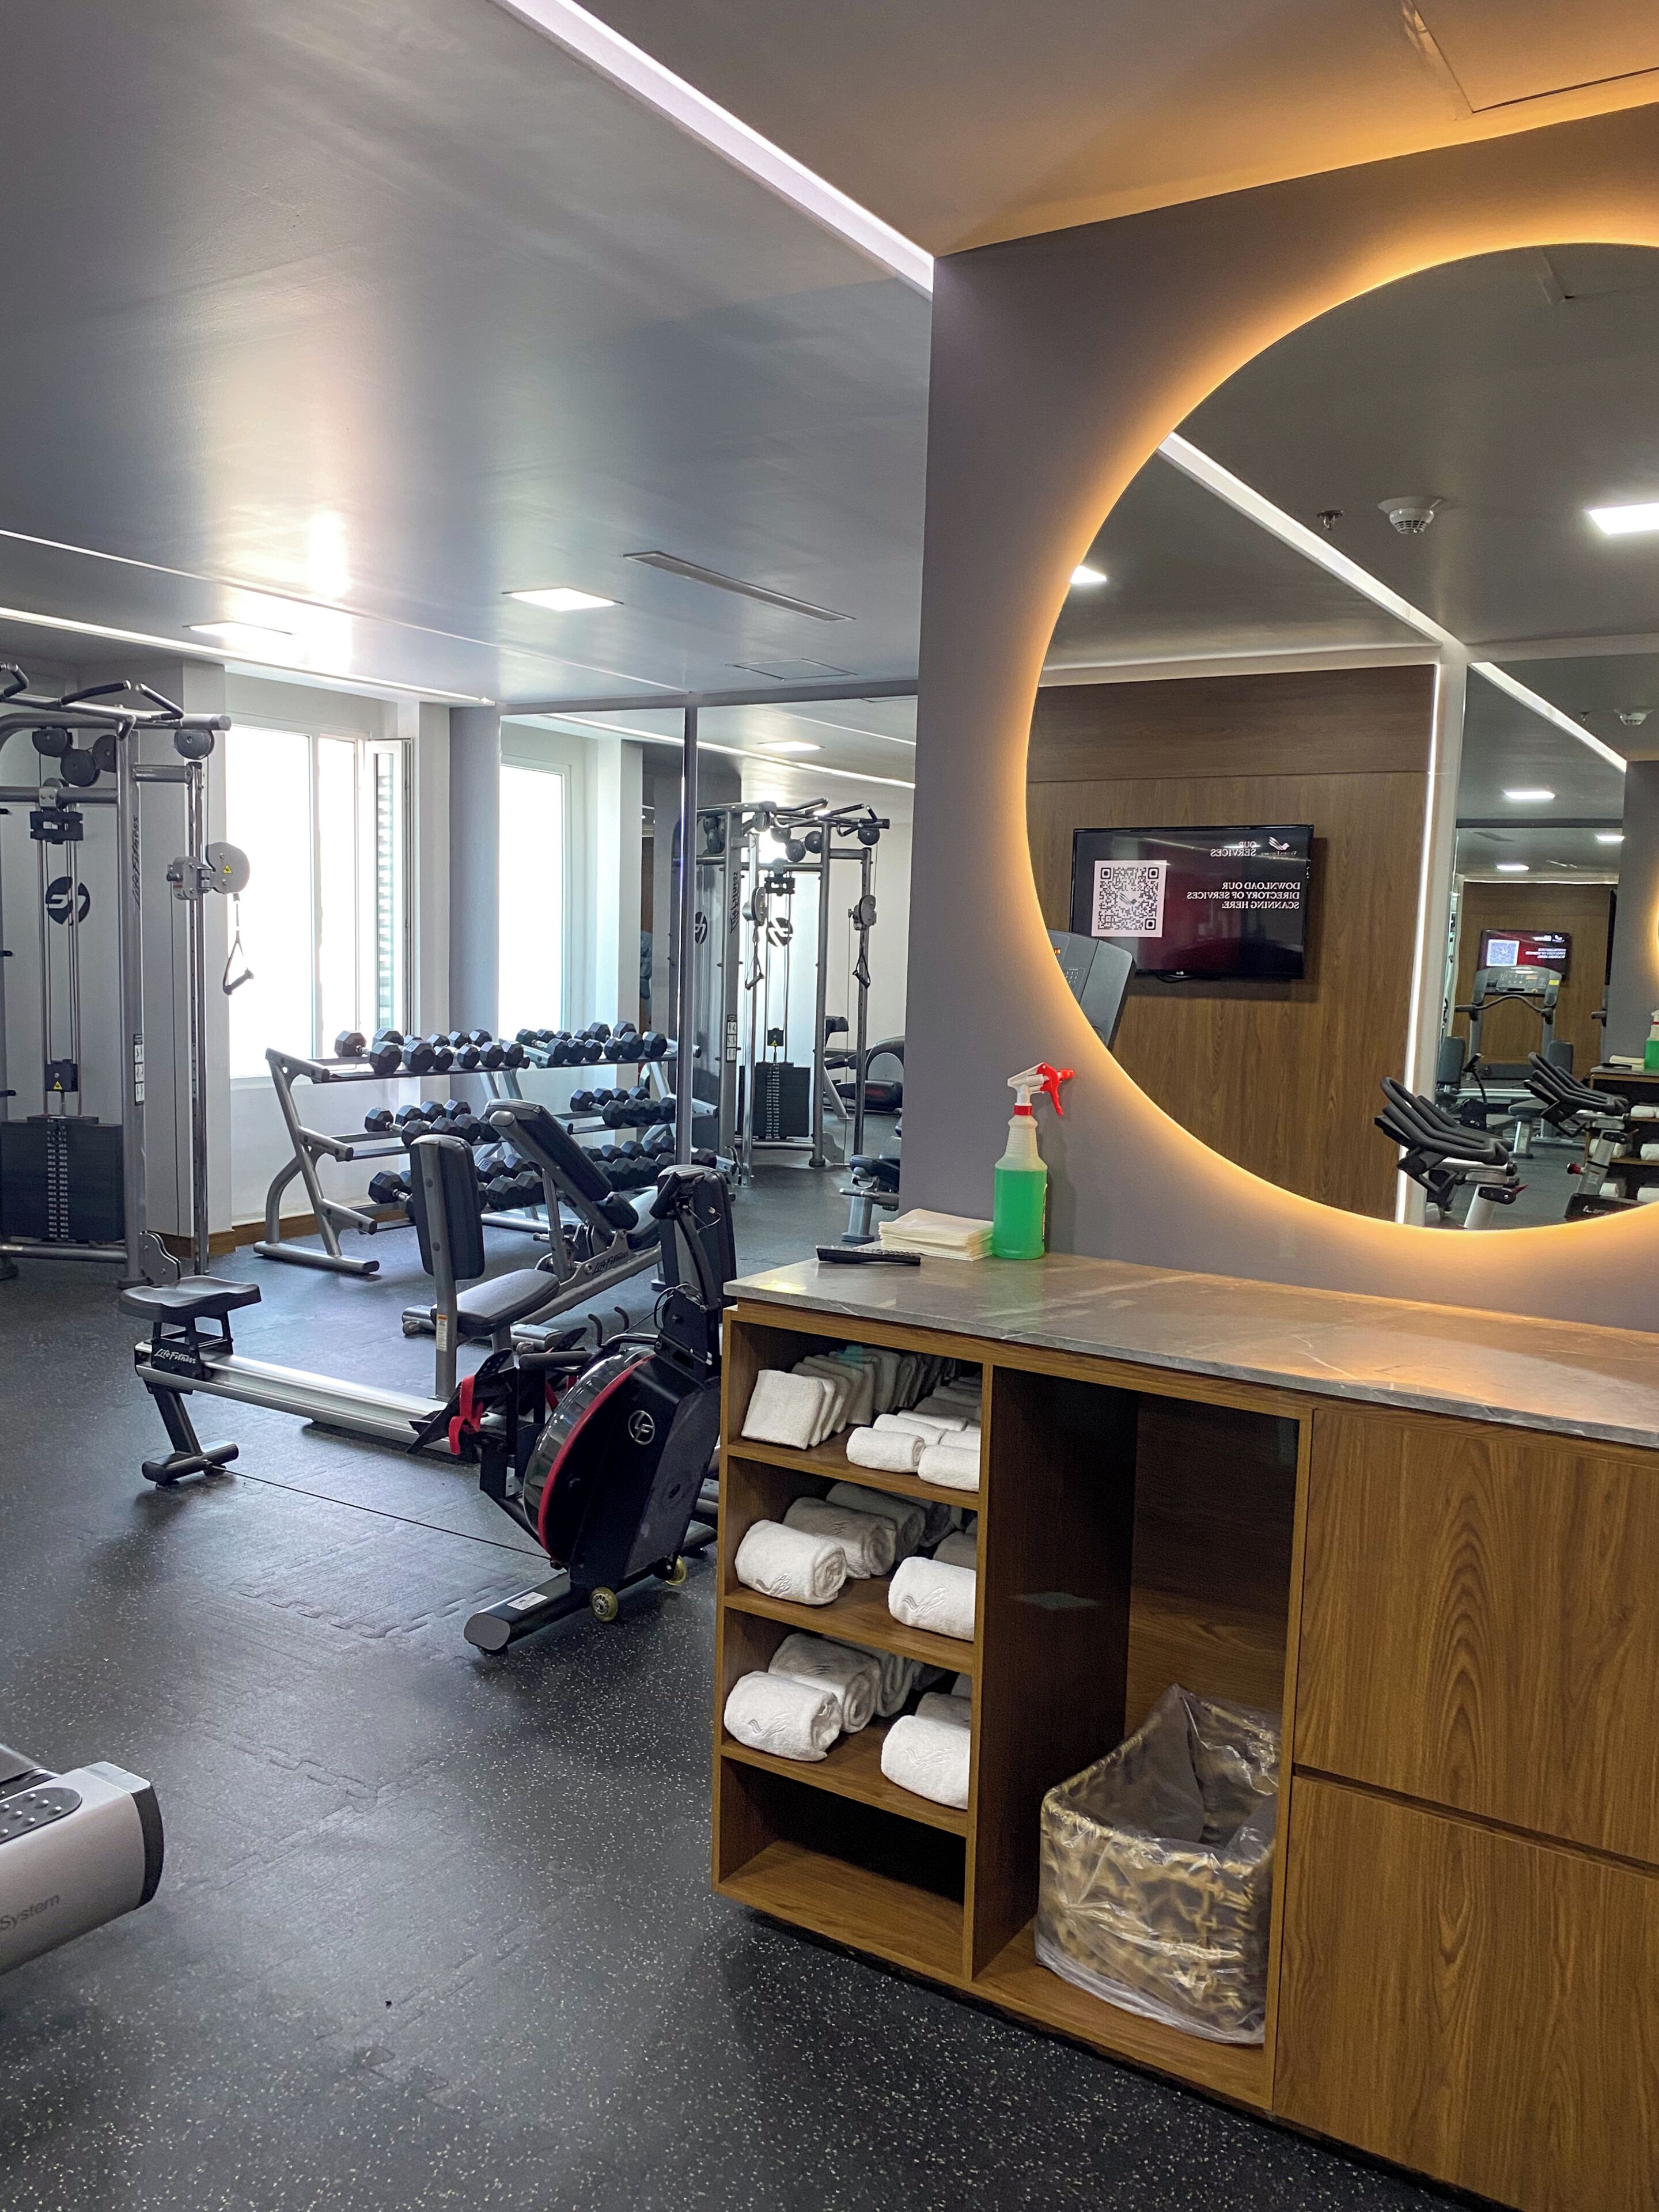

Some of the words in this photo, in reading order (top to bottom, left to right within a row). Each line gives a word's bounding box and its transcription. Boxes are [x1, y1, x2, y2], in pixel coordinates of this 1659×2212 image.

[154, 1349, 171, 1359] Life
[169, 1351, 196, 1364] Fitness
[0, 1895, 60, 1931] System
